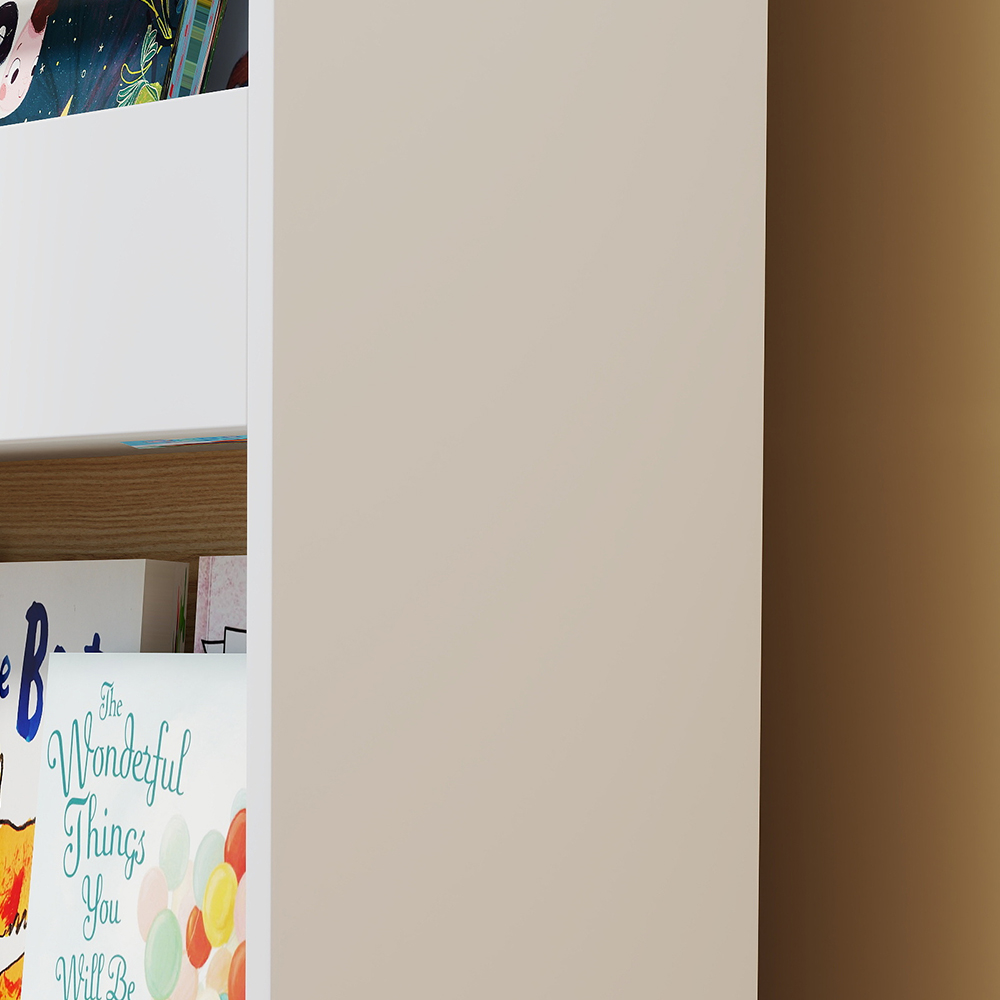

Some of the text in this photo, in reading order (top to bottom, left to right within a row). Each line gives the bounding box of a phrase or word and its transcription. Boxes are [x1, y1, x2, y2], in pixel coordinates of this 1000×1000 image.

[99, 681, 123, 721] The
[47, 711, 191, 807] Wonderful
[63, 791, 146, 880] Things
[81, 873, 122, 941] You
